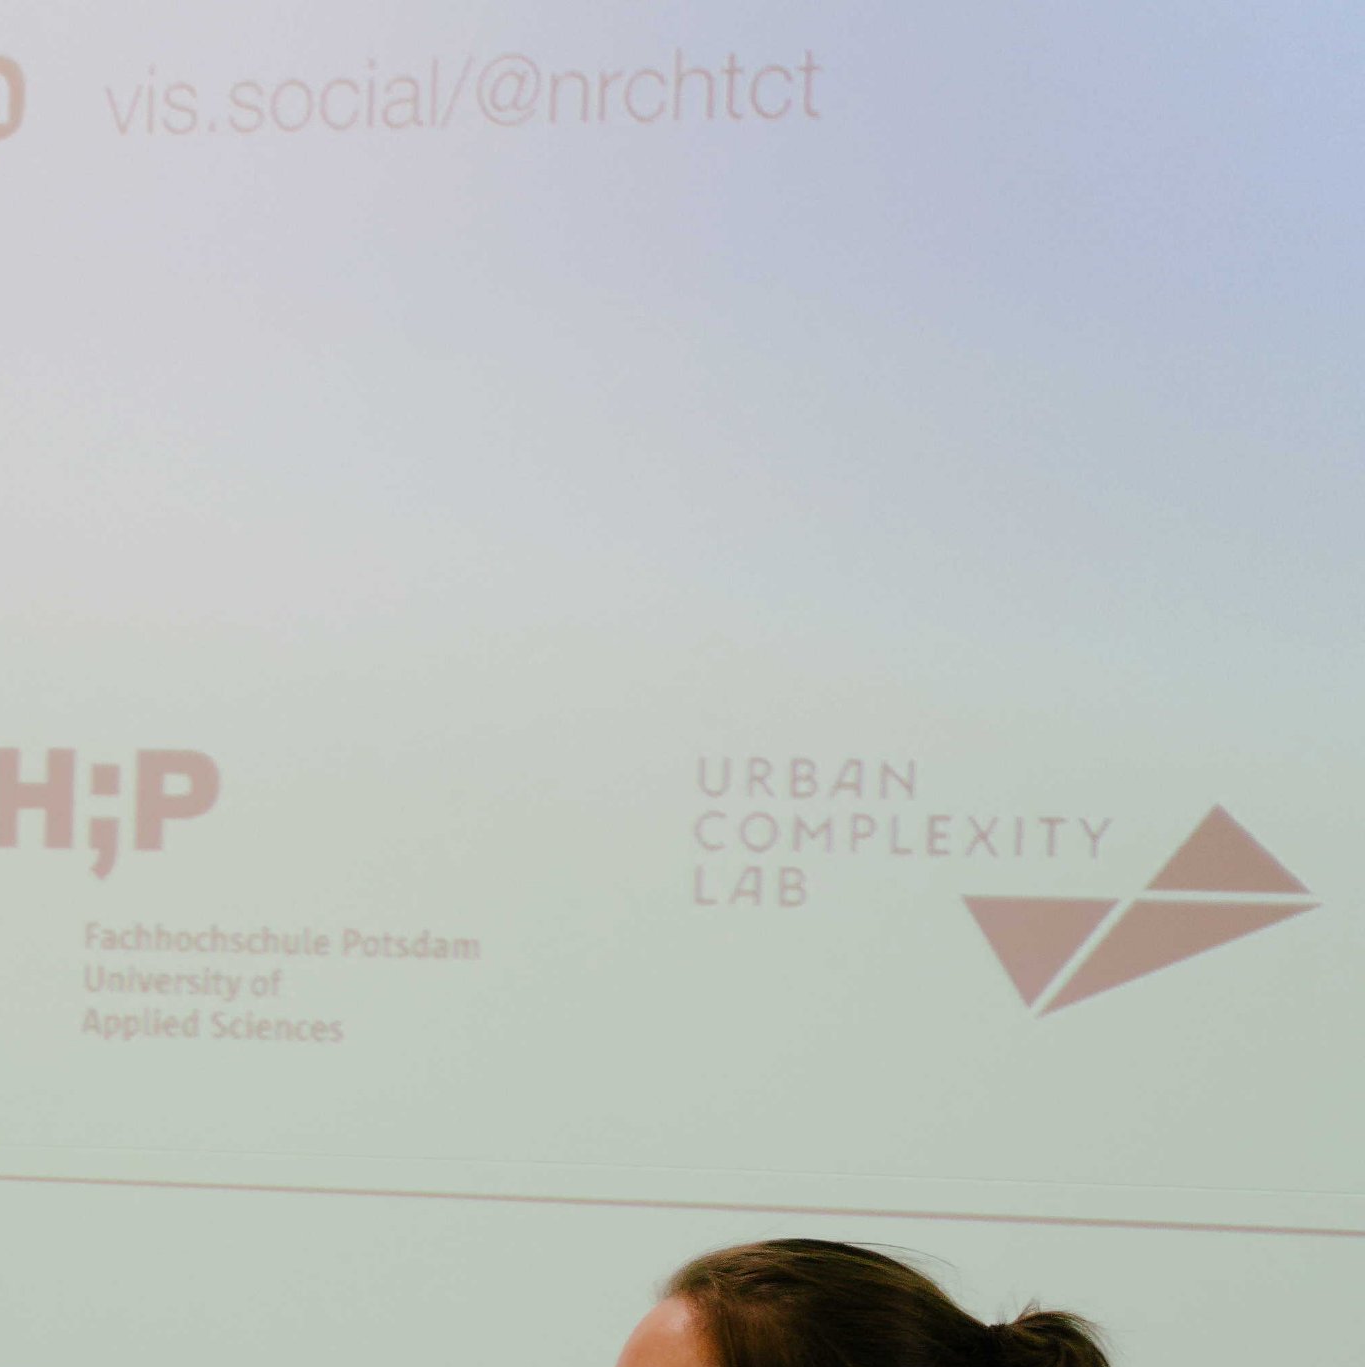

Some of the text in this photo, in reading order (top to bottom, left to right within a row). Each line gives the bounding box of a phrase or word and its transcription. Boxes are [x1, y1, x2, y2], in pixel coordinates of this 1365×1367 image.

[104, 48, 824, 136] vis.social/@nrchtct
[697, 756, 917, 800] URBAN
[692, 809, 1114, 860] COMPLEXITY
[693, 865, 808, 909] LAB
[84, 921, 481, 960] Fachhochschule Potsdam
[83, 965, 283, 1003] University of
[81, 1007, 345, 1044] Applied Sciences
